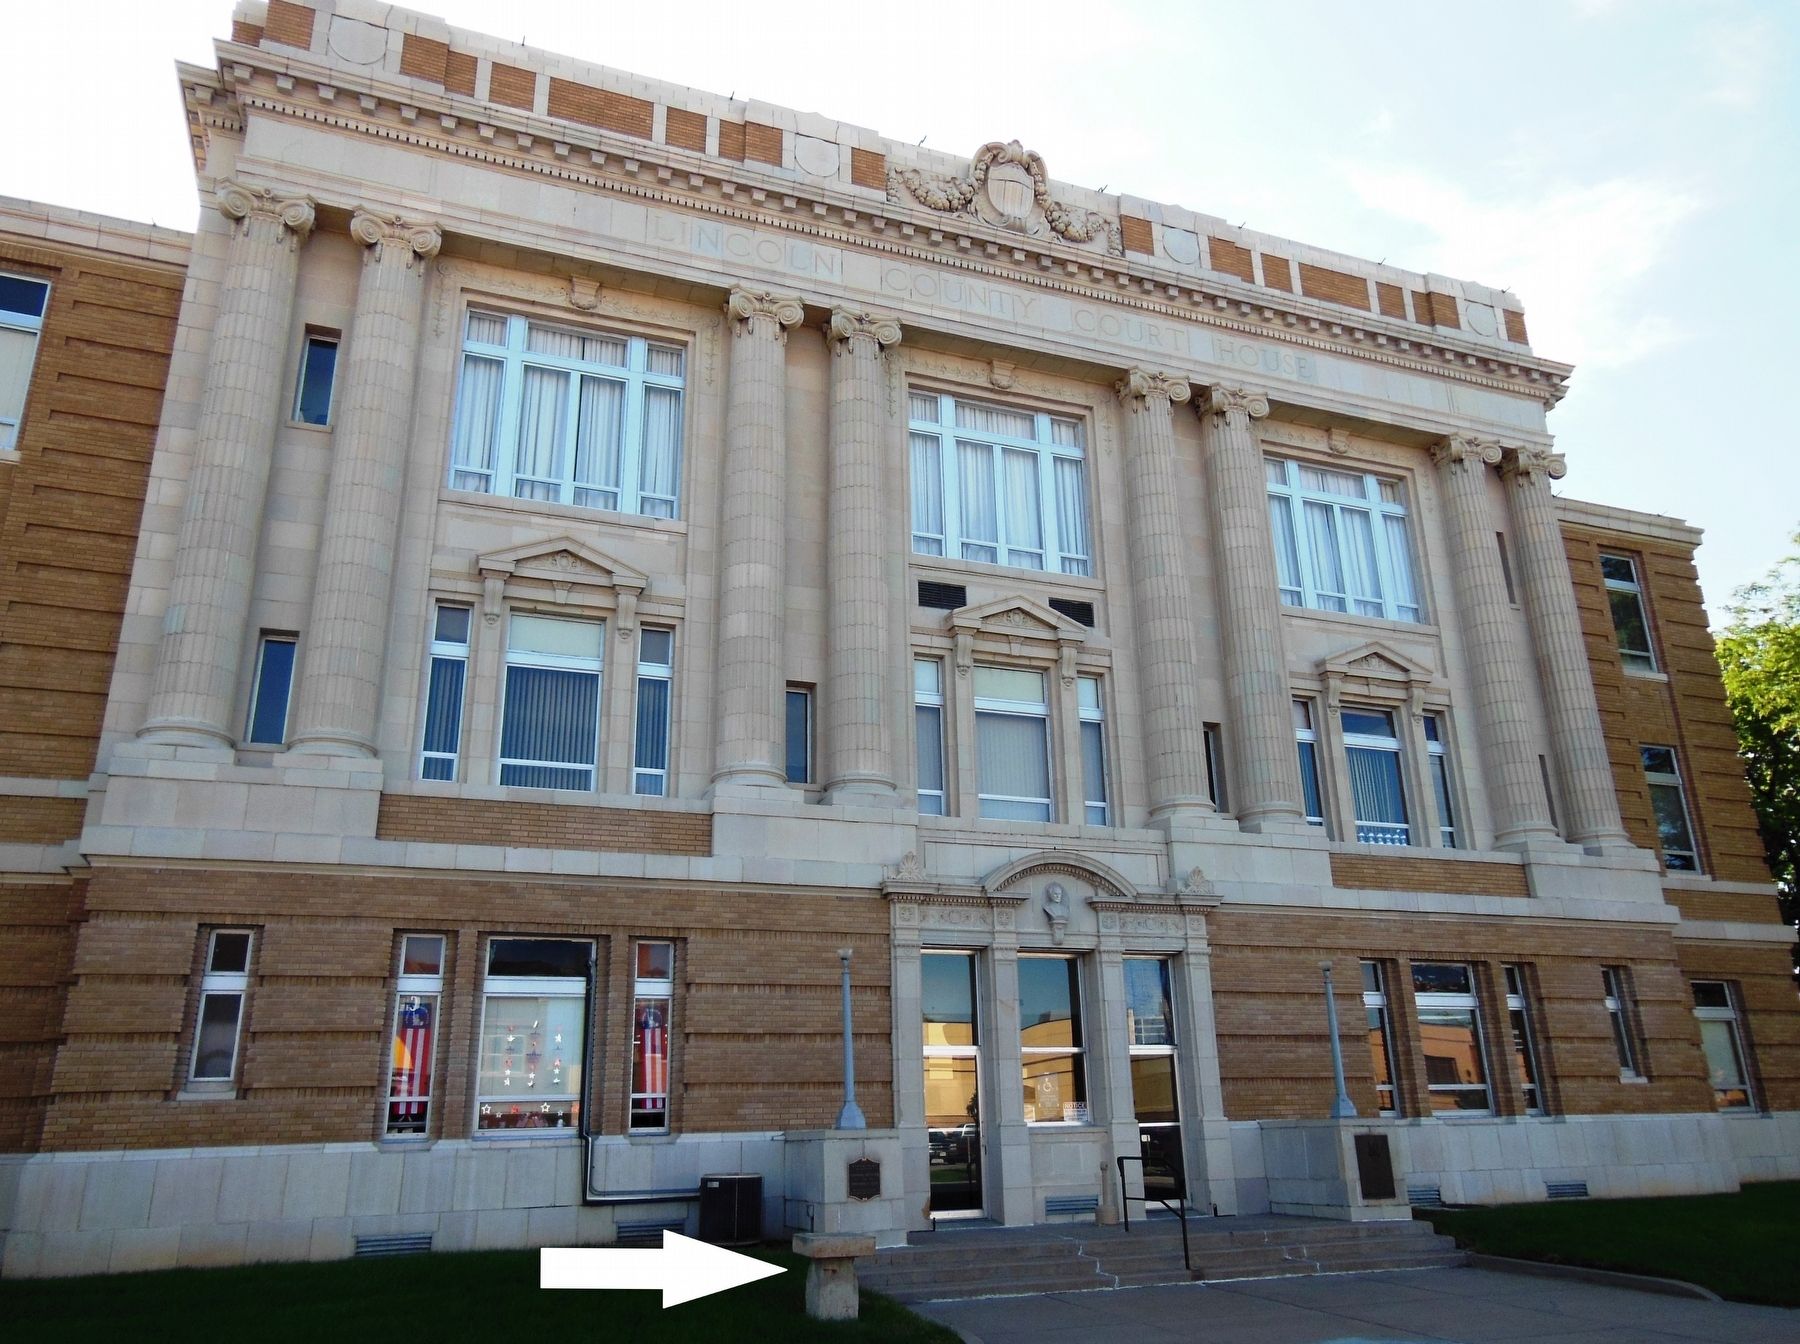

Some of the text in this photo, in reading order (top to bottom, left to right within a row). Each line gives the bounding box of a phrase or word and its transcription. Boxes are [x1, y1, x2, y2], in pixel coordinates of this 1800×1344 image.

[655, 215, 1315, 378] LINCOLN COUNTY COURT HOUSE
